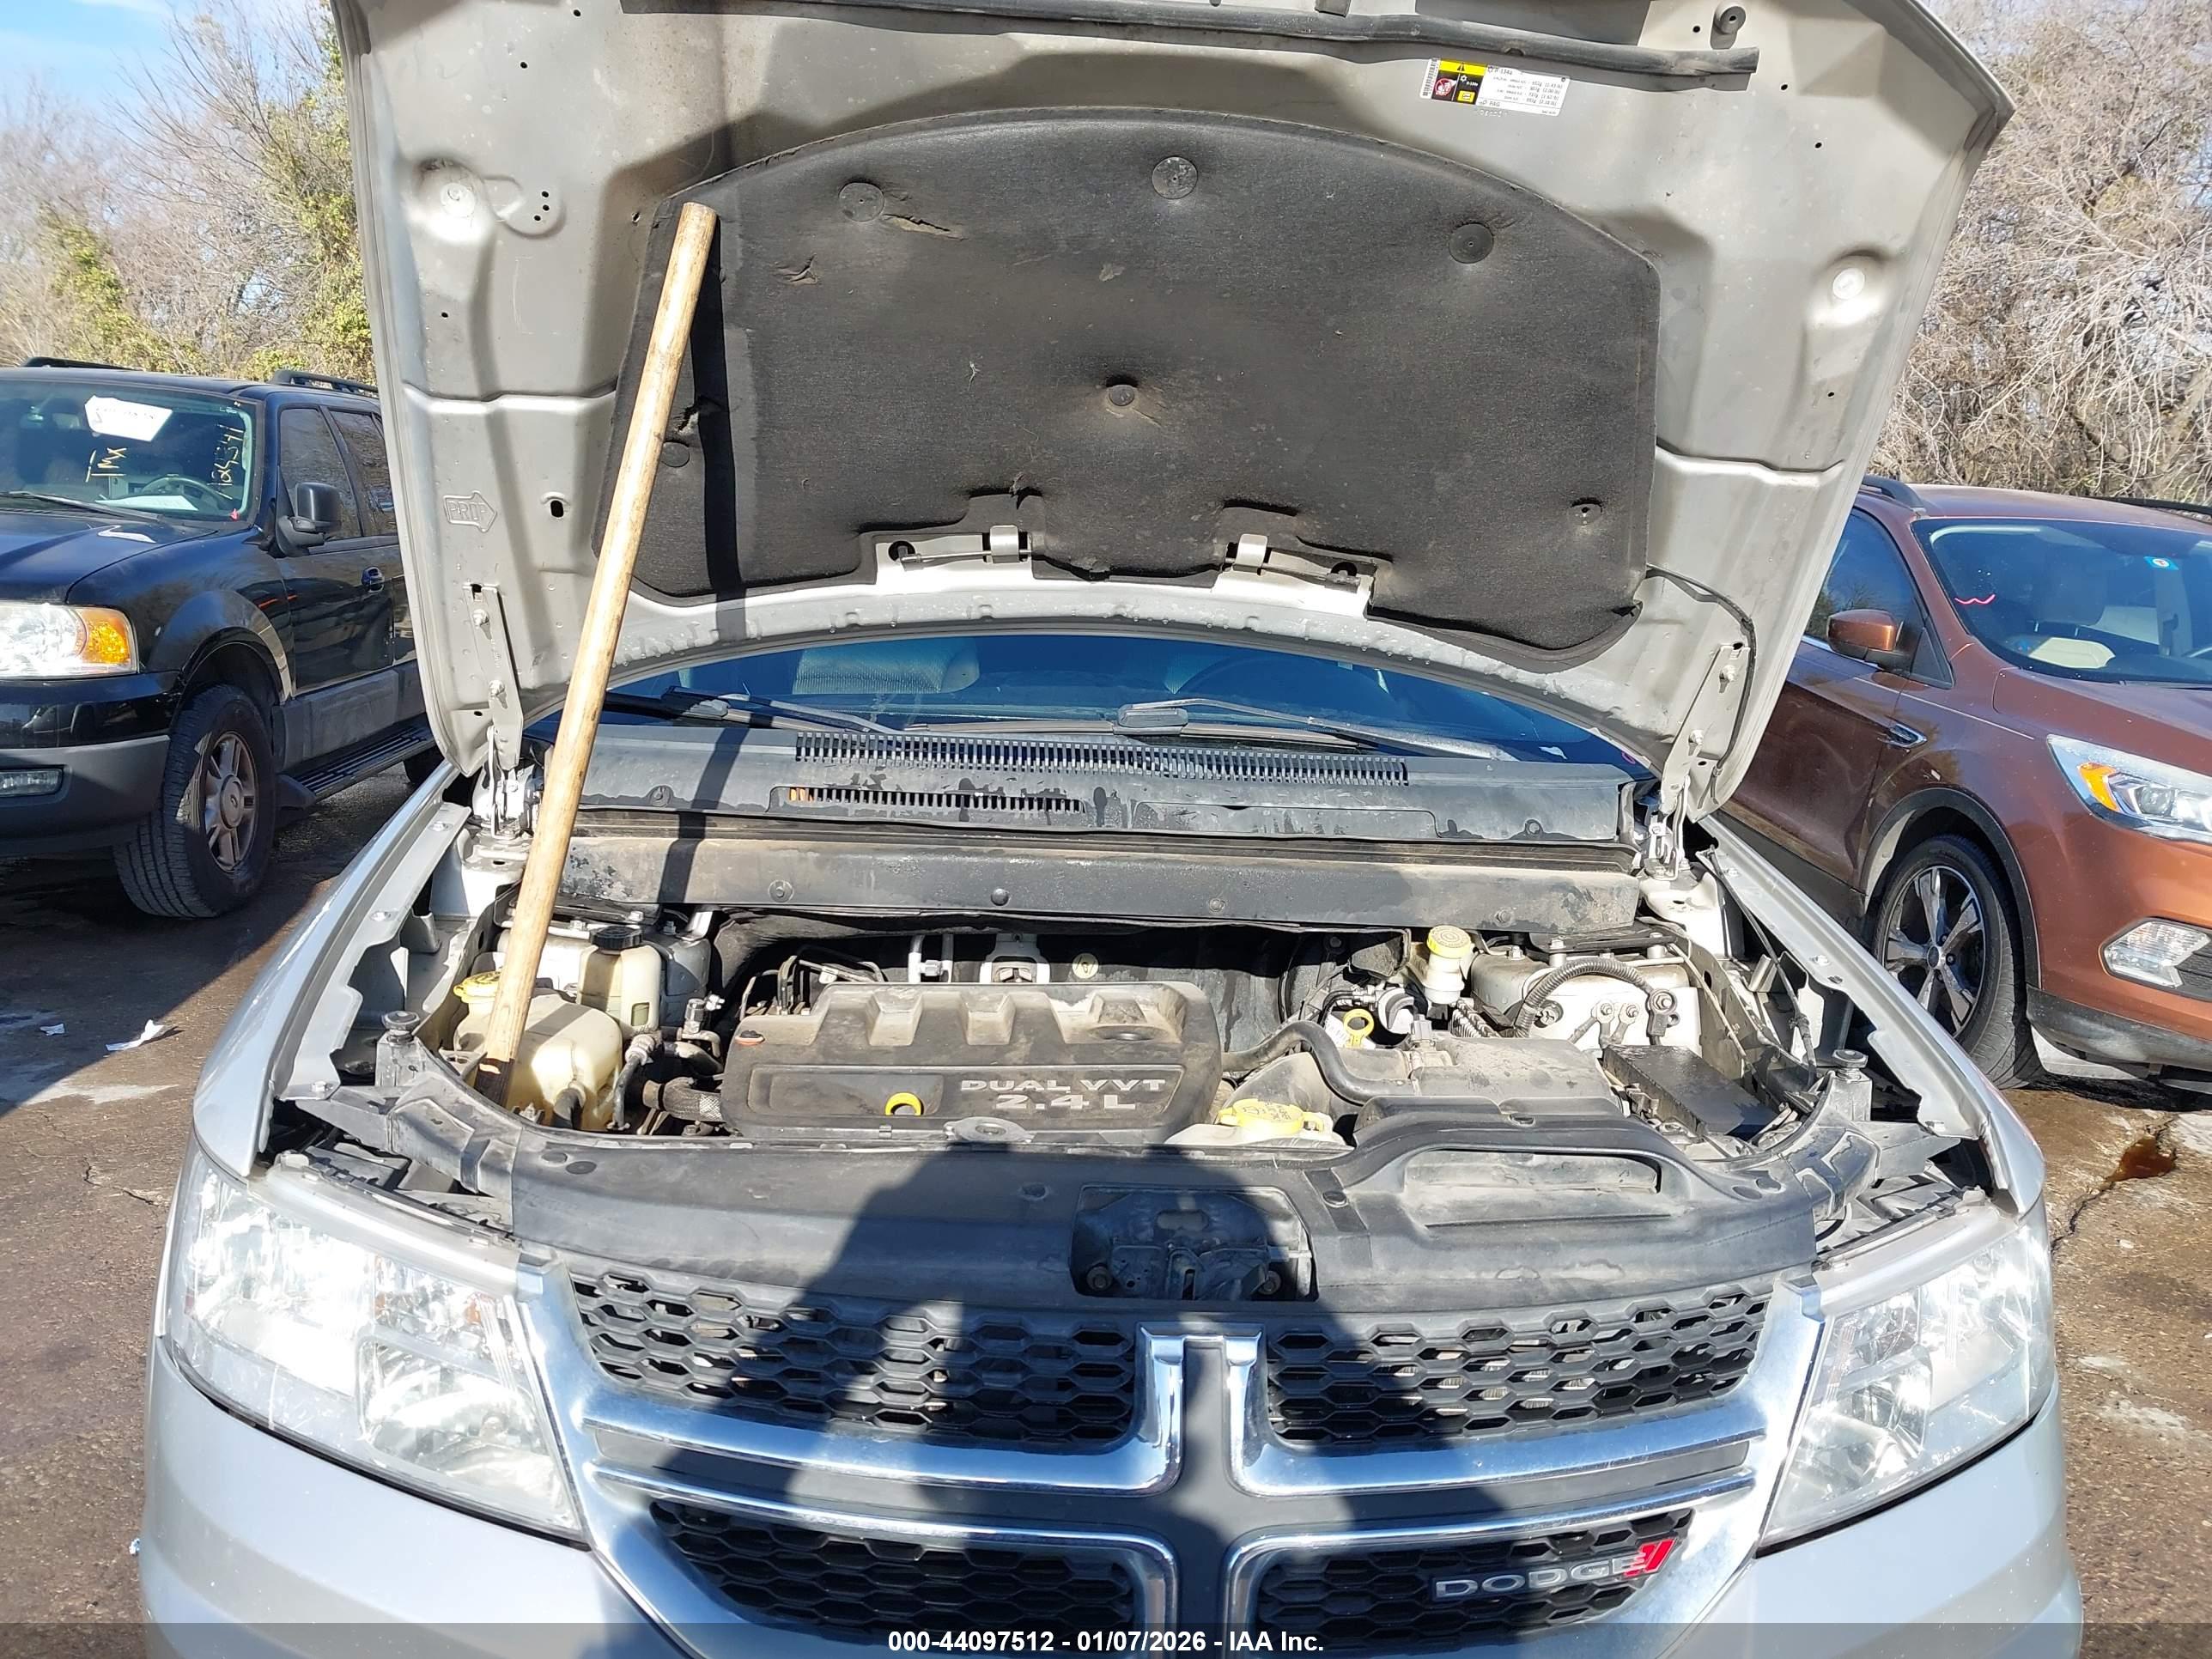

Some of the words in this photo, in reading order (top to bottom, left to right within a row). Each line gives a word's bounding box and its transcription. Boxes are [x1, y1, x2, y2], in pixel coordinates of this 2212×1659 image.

[961, 1079, 1071, 1092] DUAL
[1079, 1079, 1166, 1091] VVT
[1435, 1552, 1647, 1599] DODGE
